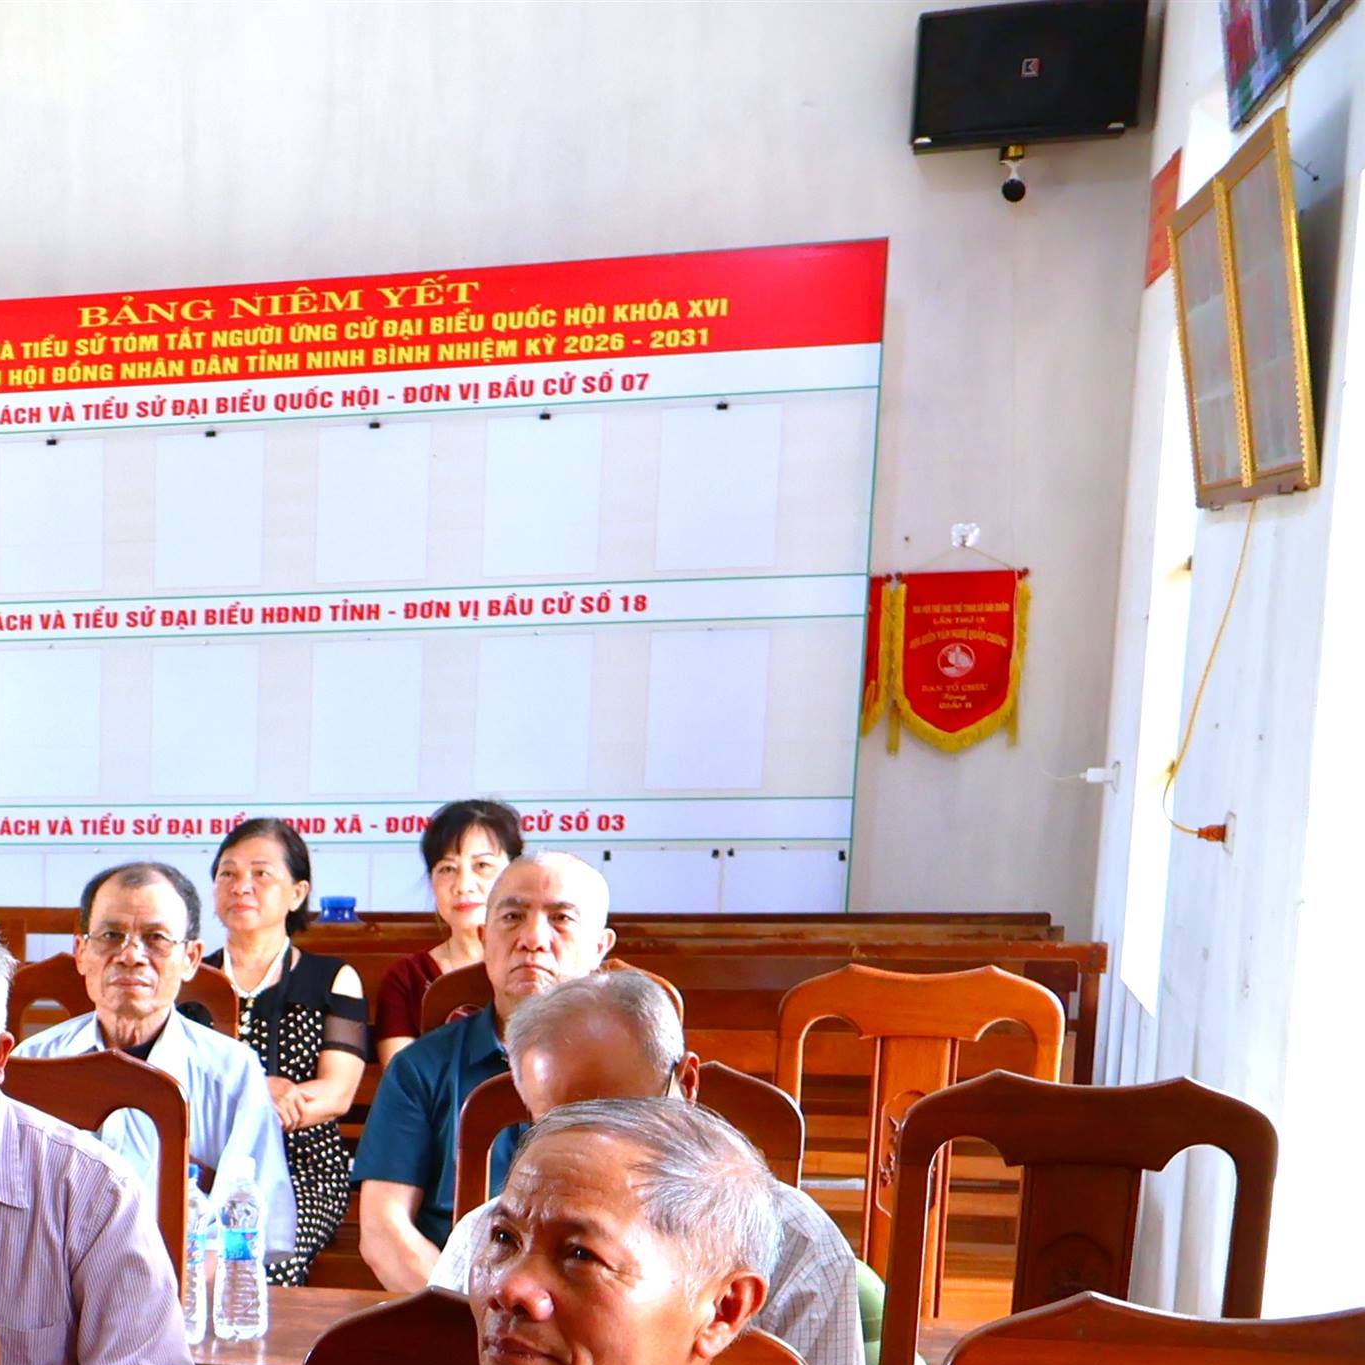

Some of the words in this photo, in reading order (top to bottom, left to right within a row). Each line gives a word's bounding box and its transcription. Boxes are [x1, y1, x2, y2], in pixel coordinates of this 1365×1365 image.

[21, 334, 67, 358] TIỂU
[75, 332, 107, 356] SỬ
[112, 331, 159, 353] TÓM
[165, 327, 205, 350] TẮT
[212, 323, 282, 348] NGƯỜI
[289, 321, 337, 343] ỨNG
[345, 316, 378, 340] CỬ
[382, 316, 422, 341] ĐẠI
[430, 307, 484, 334] BIỂU
[491, 304, 557, 332] QUỐC
[564, 303, 605, 328] HỘI
[613, 299, 680, 323] KHÓA
[687, 297, 728, 318] XVI
[77, 296, 216, 328] BẢNG
[229, 286, 364, 318] NIÊM
[377, 274, 480, 308] YẾT
[9, 366, 45, 389] HỘI
[52, 359, 113, 384] ĐỒNG
[121, 357, 184, 380] NHÂN
[191, 355, 239, 376] DÂN
[246, 349, 300, 371] TỈNH
[306, 349, 365, 369] NINH
[373, 343, 430, 366] BÌNH
[437, 337, 517, 362] NHIỆM
[525, 334, 557, 356] KỲ
[564, 333, 625, 354] 2026
[649, 328, 709, 348] 2031
[49, 402, 79, 422] VÀ
[82, 396, 128, 420] TIỂU
[136, 395, 166, 418] SỬ
[171, 397, 208, 419] ĐẠI
[215, 388, 266, 414] BIỂU
[273, 386, 334, 412] QUỐC
[341, 385, 379, 410] HỘI
[403, 383, 450, 404] ĐƠN
[459, 383, 480, 404] VỊ
[488, 374, 534, 399] BẦU
[543, 371, 575, 396] CỬ
[581, 368, 614, 393] SỐ
[621, 372, 650, 391] 07
[40, 609, 66, 630] VÀ
[72, 605, 118, 629] TIỂU
[126, 604, 154, 628] SỬ
[160, 609, 196, 631] ĐẠI
[204, 602, 253, 626] BIỂU
[261, 605, 320, 624] HĐND
[329, 599, 380, 622] TỈNH
[403, 600, 451, 619] ĐƠN
[458, 600, 480, 622] VỊ
[487, 593, 533, 617] BẦU
[541, 591, 575, 615] CỬ
[580, 589, 611, 614] SỐ
[620, 595, 648, 612] 18
[48, 815, 73, 836] VÀ
[79, 813, 125, 835] TIỂU
[132, 813, 162, 835] SỬ
[166, 818, 202, 839] ĐẠI
[210, 811, 246, 834] BIỂ
[333, 813, 362, 833] XÃ
[386, 813, 431, 833] ĐƠN
[522, 809, 554, 832] CỬ
[559, 809, 589, 831] SỐ
[597, 814, 625, 831] 03
